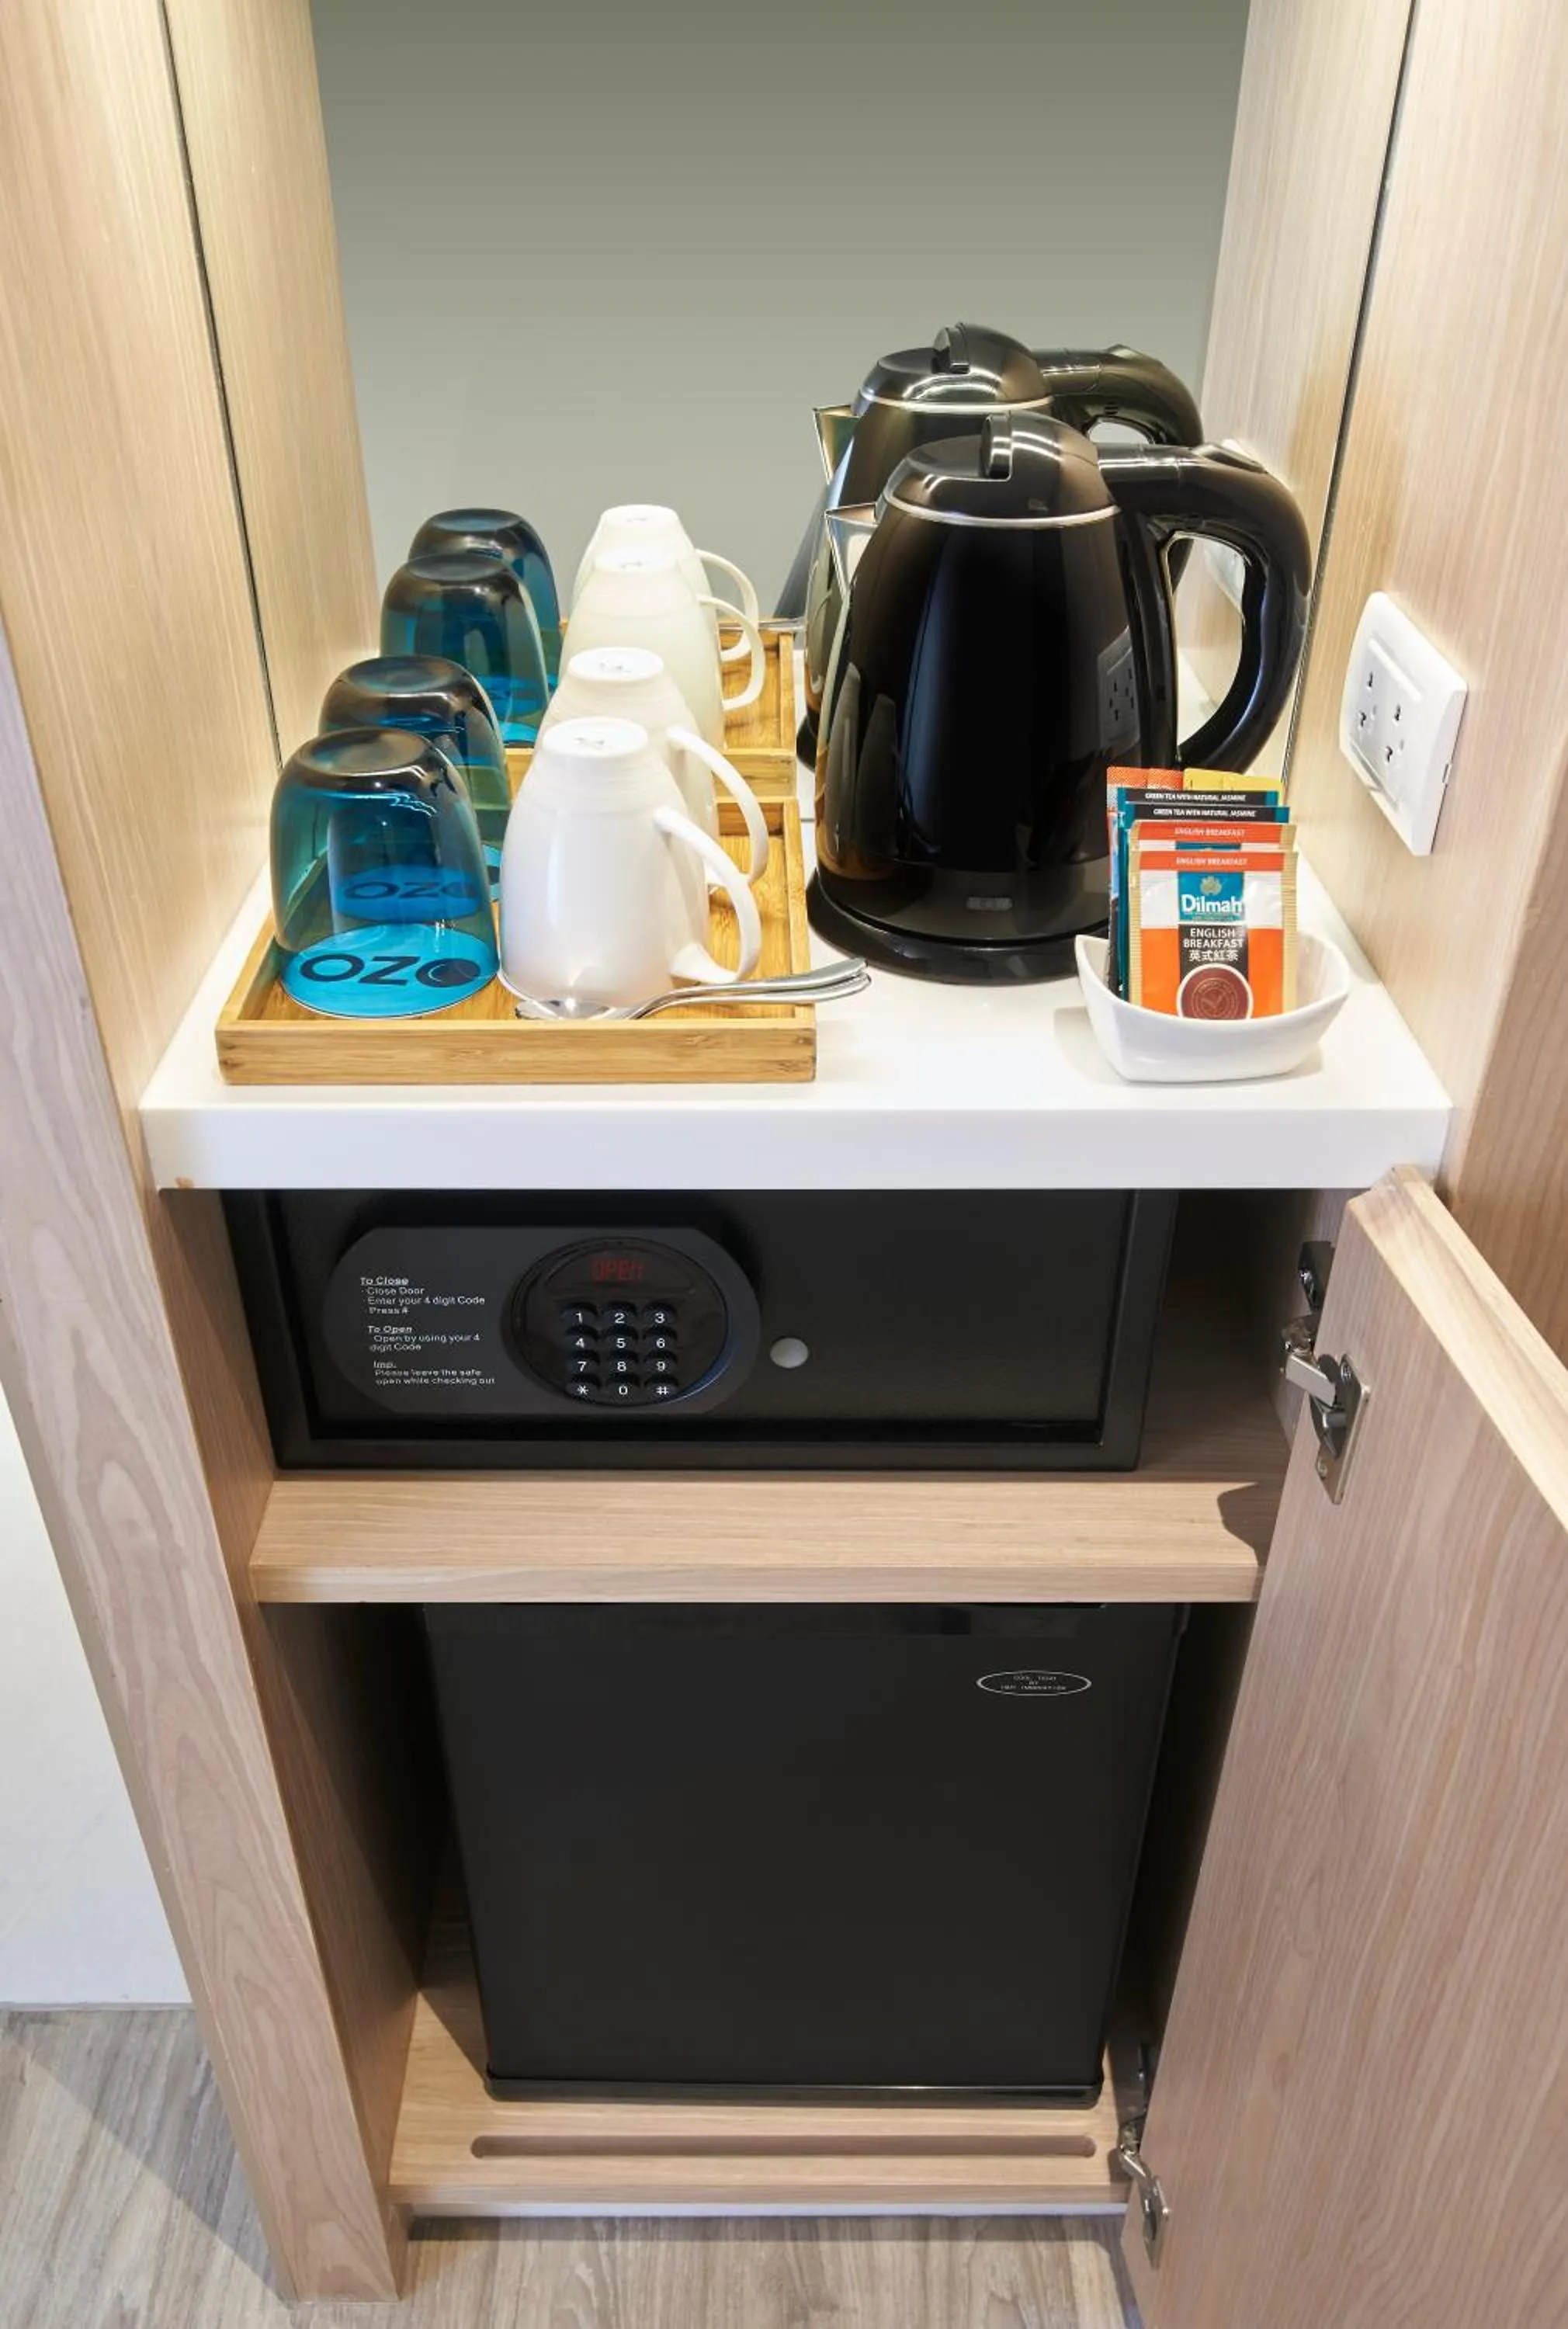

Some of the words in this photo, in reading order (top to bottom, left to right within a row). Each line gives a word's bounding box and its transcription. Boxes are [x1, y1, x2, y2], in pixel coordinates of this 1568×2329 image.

[1174, 827, 1204, 836] ENGLISH
[1205, 828, 1246, 837] BREAKFAST
[1207, 857, 1247, 866] BREAKFAST
[1181, 894, 1243, 914] Dilmah
[1190, 928, 1235, 939] ENGLISH
[1184, 939, 1244, 949] BREAKFAST
[1189, 949, 1239, 962] 英式紅茶
[360, 1277, 373, 1286] To
[376, 1276, 409, 1286] Close
[398, 1298, 421, 1307] your
[432, 1296, 456, 1307] digit
[457, 1296, 485, 1305] Code
[576, 1313, 583, 1323] 1
[615, 1313, 624, 1323] 2
[655, 1313, 665, 1323] 3
[367, 1325, 381, 1334] To
[383, 1325, 413, 1335] Open
[373, 1335, 403, 1343] Open
[404, 1335, 417, 1343] by
[418, 1335, 446, 1343] using
[449, 1335, 470, 1345] your
[575, 1338, 585, 1348] 4
[617, 1338, 626, 1348] 5
[657, 1338, 665, 1348] 6
[394, 1343, 421, 1352] Code
[578, 1362, 586, 1372] 7
[617, 1362, 626, 1372] 8
[657, 1362, 665, 1372] 9
[376, 1377, 401, 1386] open
[431, 1377, 477, 1386] checking
[618, 1386, 627, 1395] 0
[656, 1386, 669, 1395] #
